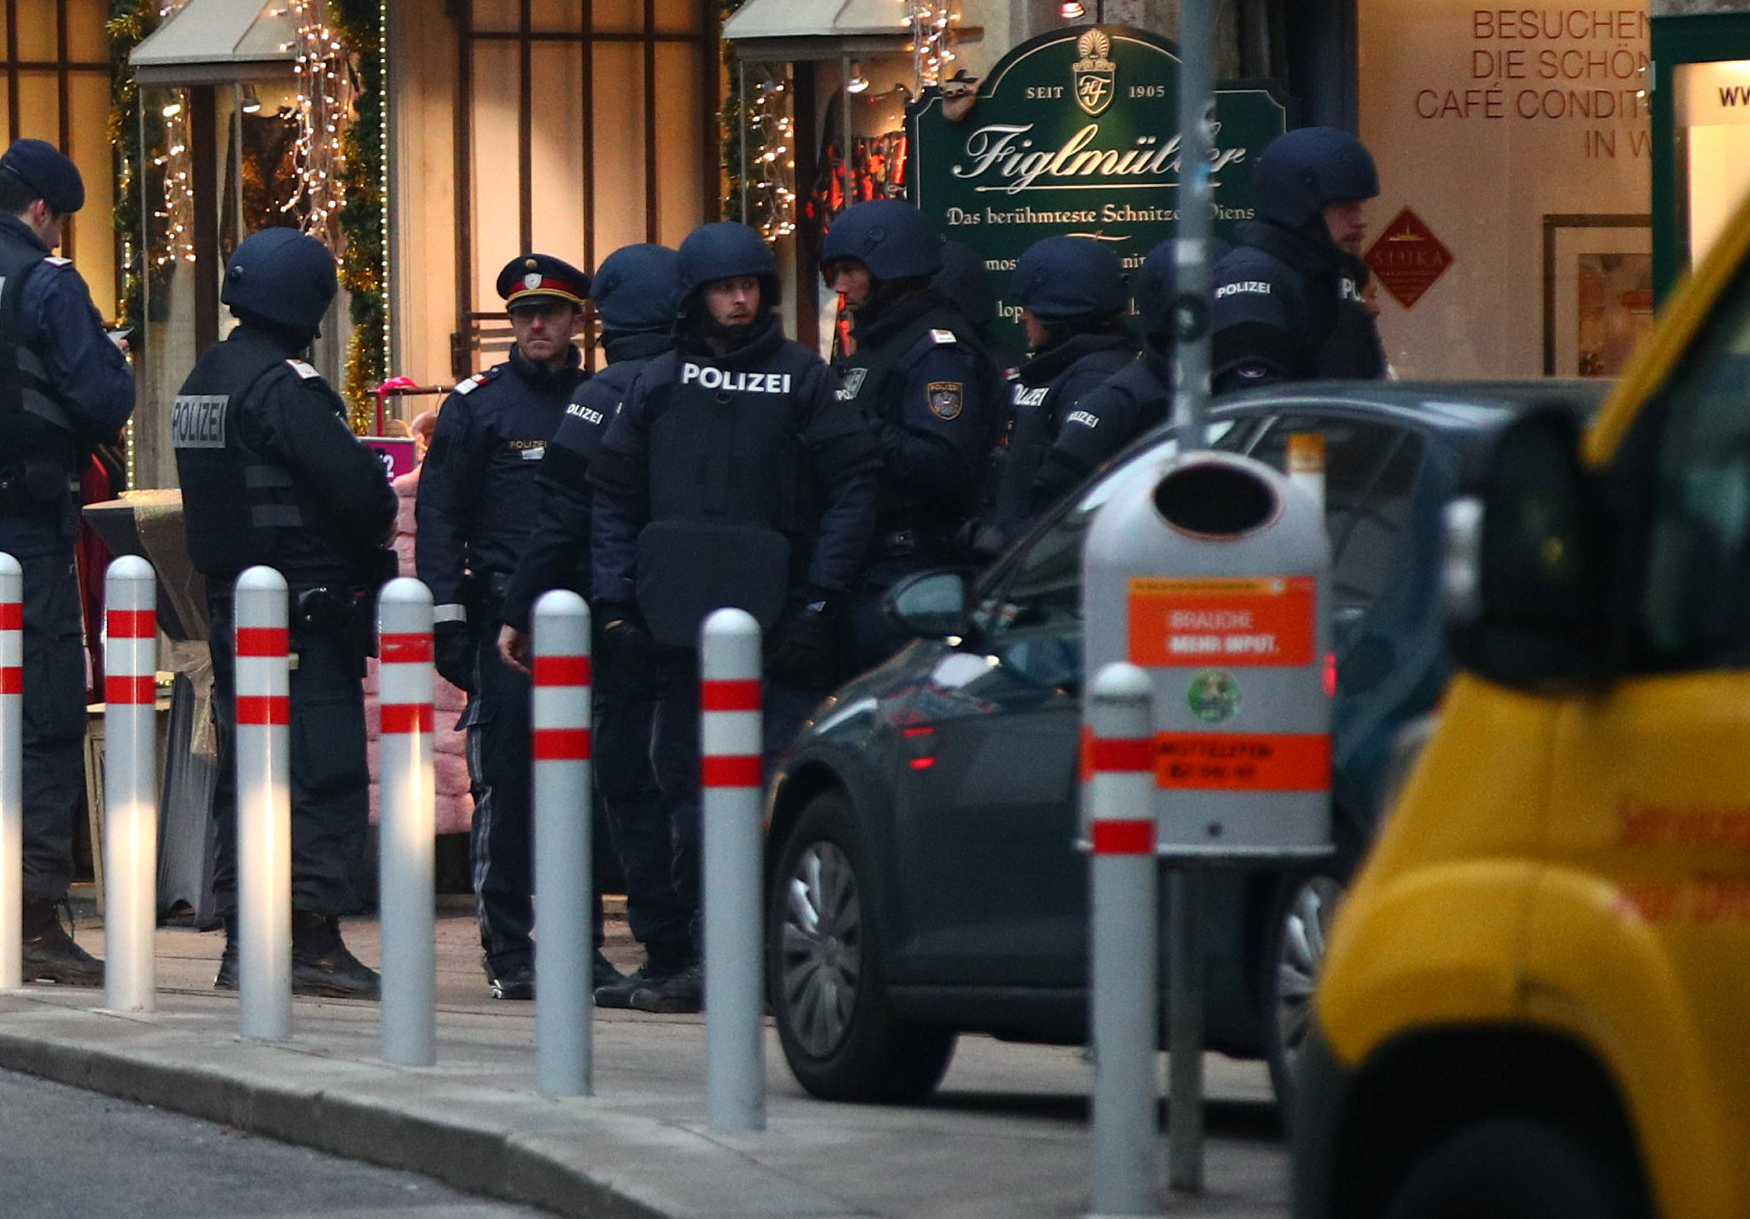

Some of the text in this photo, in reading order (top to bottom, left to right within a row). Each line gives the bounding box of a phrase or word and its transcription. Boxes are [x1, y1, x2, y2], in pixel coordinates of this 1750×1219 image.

[1472, 49, 1525, 79] DIE
[1026, 86, 1063, 99] SEIT
[1129, 86, 1165, 98] 1905
[1416, 82, 1651, 119] CAFÉ CONDIT
[1586, 130, 1616, 158] IN
[947, 207, 981, 225] Das
[986, 206, 1097, 224] berühmteste
[1216, 282, 1271, 298] POLIZEI
[683, 362, 791, 394] POLIZEI
